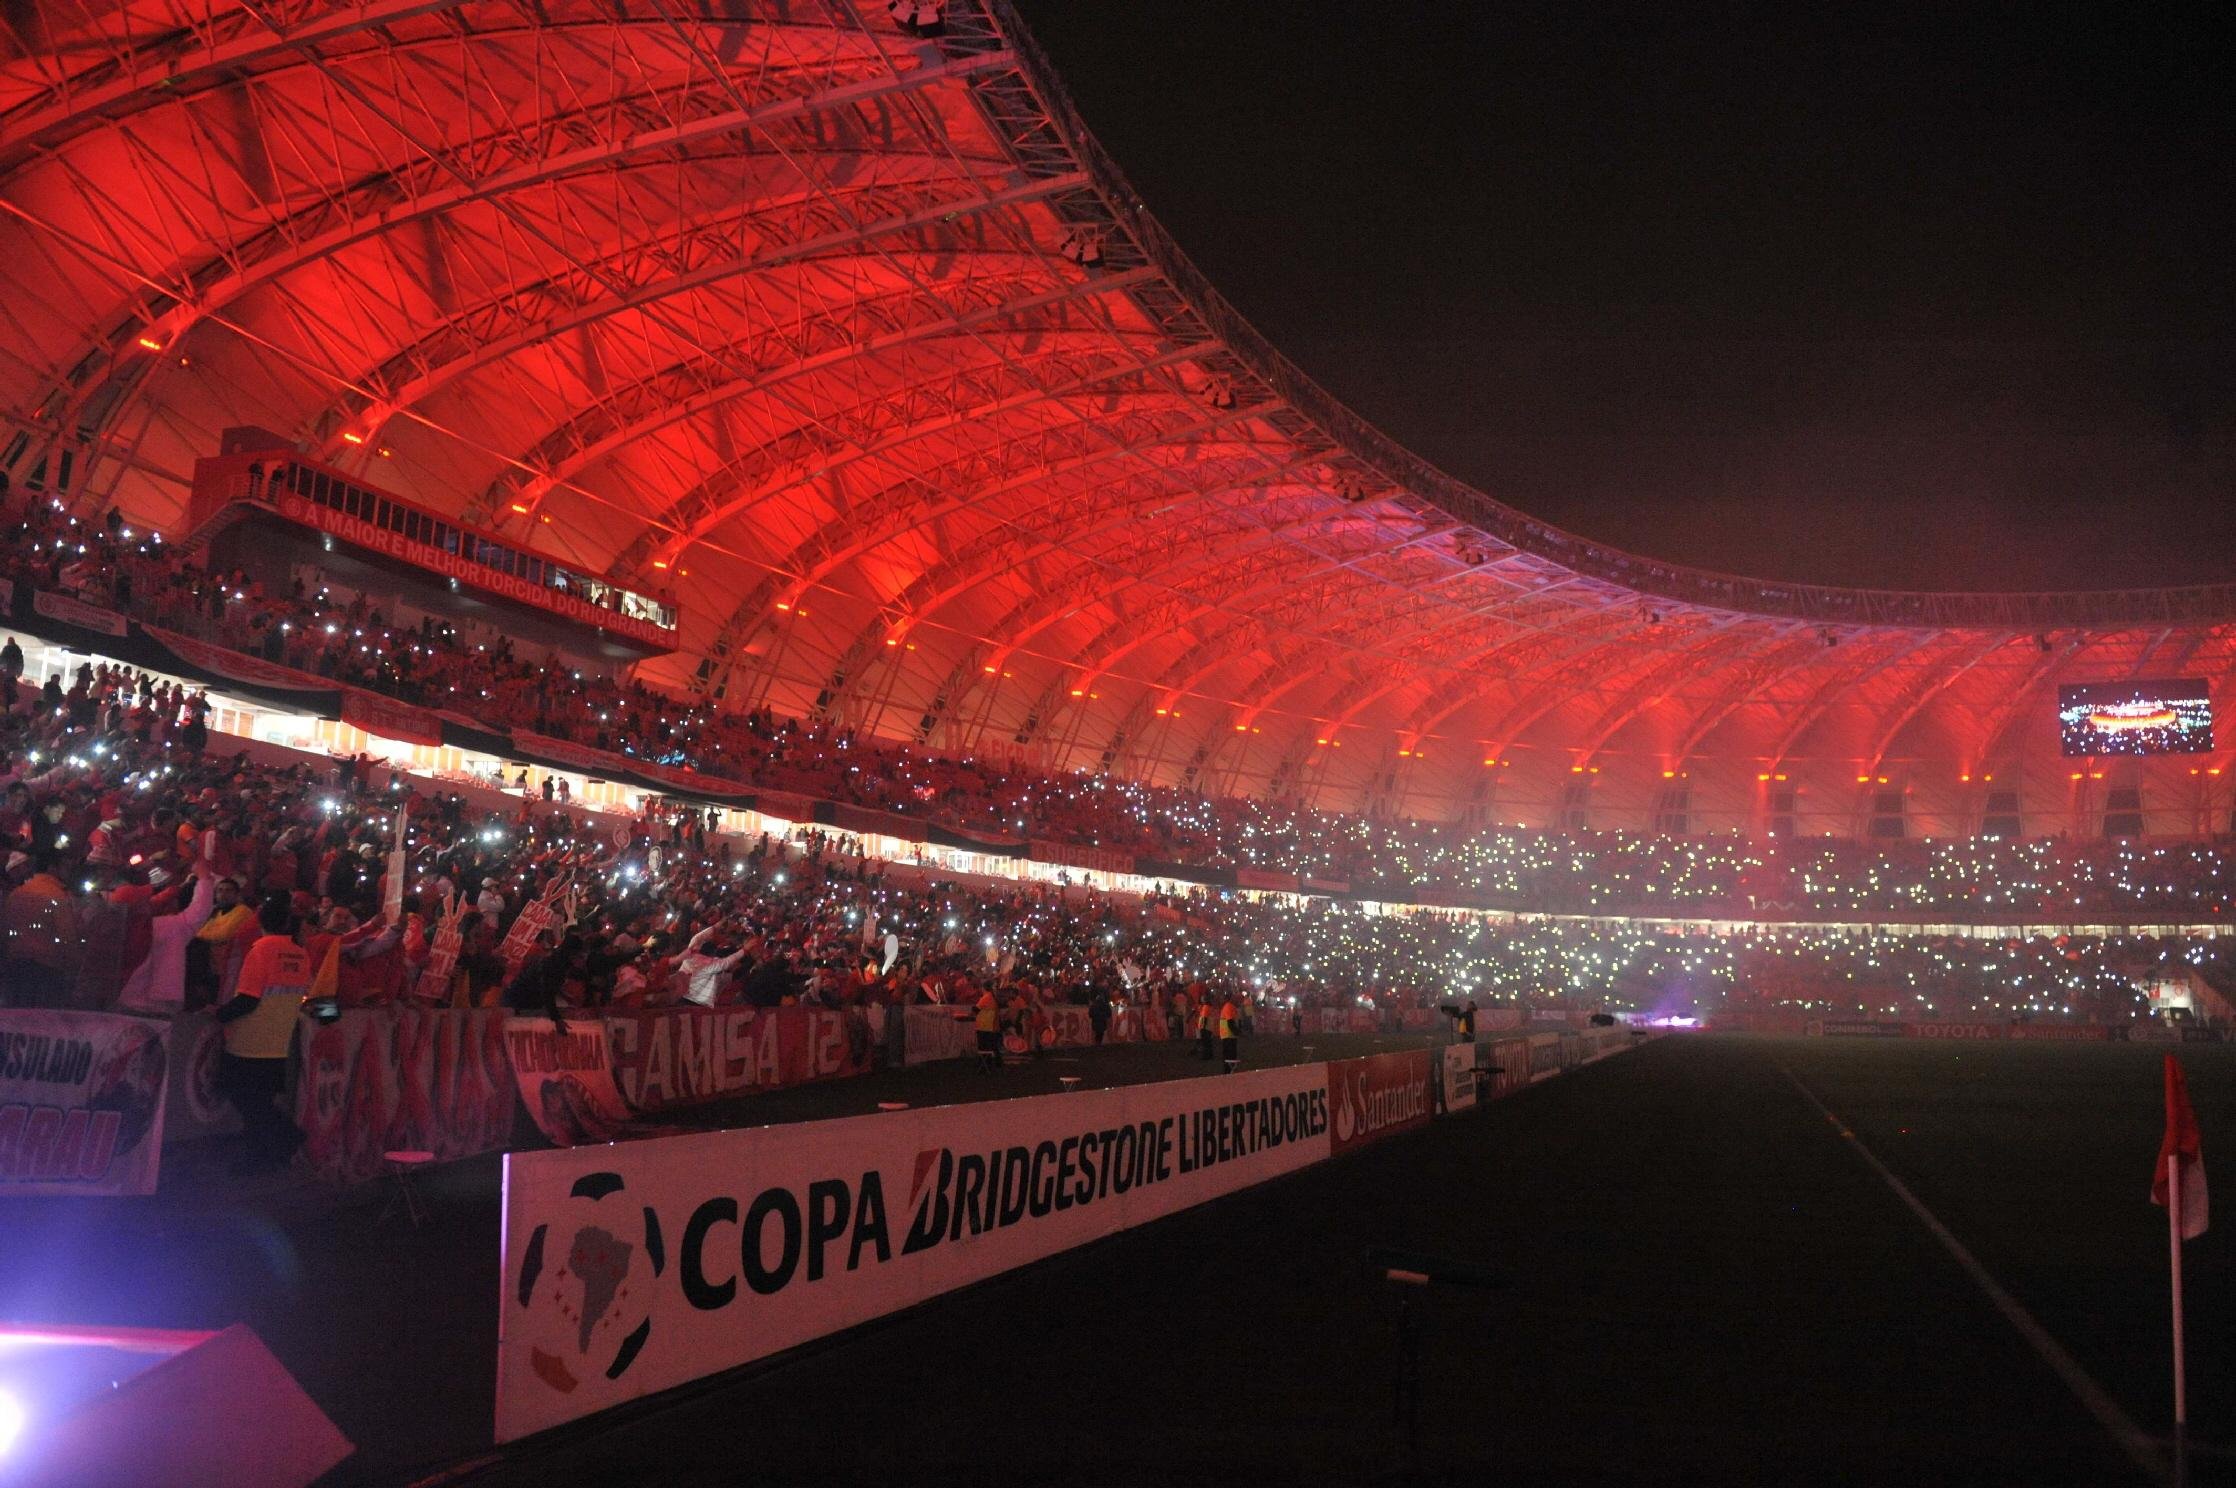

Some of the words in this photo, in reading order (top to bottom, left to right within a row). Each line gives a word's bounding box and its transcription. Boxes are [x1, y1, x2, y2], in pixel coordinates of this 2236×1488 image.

[304, 506, 319, 525] A
[324, 513, 389, 551] MAIOR
[391, 536, 404, 556] E
[406, 543, 480, 582] MELHOR
[484, 568, 553, 606] TORCIDA
[556, 594, 577, 615] DO
[580, 604, 605, 624] RIO
[607, 612, 667, 644] GRANDE
[607, 1010, 781, 1104] CAMISA
[807, 1010, 843, 1079] 12
[1911, 1024, 1990, 1039] TOYOTA
[1357, 1055, 1426, 1136] Santander
[679, 1170, 892, 1312] COPA
[901, 1116, 1173, 1256] BRIDGESTONE
[1178, 1088, 1328, 1176] LIBERTADORES
